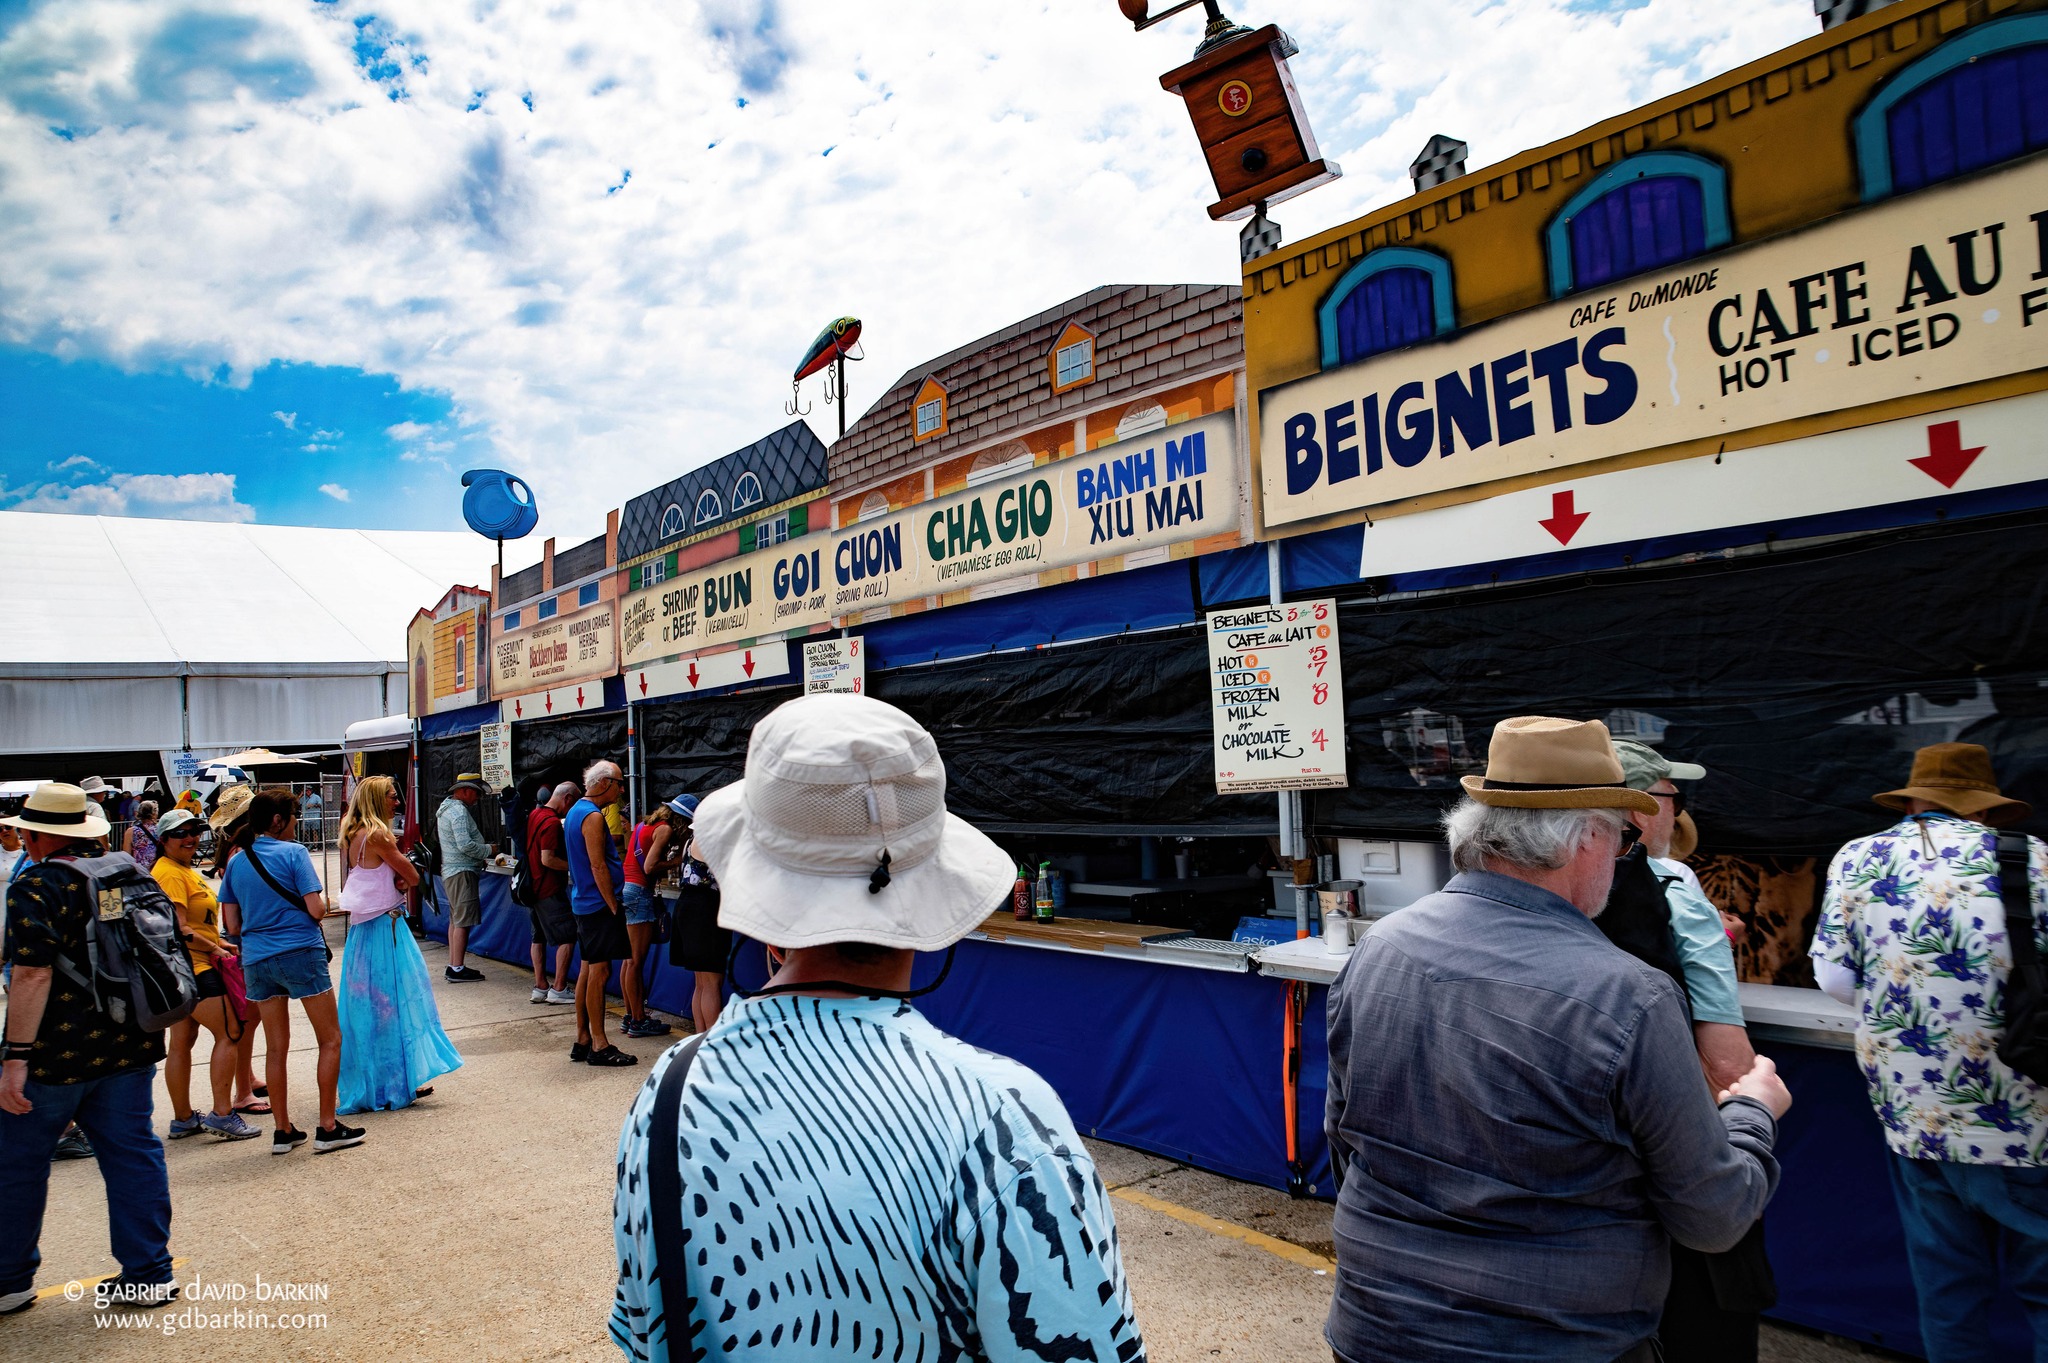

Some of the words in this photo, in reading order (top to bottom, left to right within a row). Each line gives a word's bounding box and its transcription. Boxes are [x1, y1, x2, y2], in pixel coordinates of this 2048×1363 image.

[1708, 261, 1870, 357] CAFE
[1897, 222, 2005, 314] AU
[1570, 298, 1616, 328] CAFE
[1719, 348, 1796, 397] HOT
[1852, 313, 1961, 366] ICED
[1284, 326, 1638, 496] BEIGNETS
[1077, 448, 1156, 508] BANH
[1166, 431, 1206, 482] MI
[926, 497, 992, 562] CHA
[996, 479, 1052, 544] GIO
[1088, 498, 1134, 544] XIU
[1146, 480, 1204, 532] MAI
[774, 548, 820, 600] GOI
[835, 522, 902, 586] CUON
[936, 555, 992, 582] (VIETNAMESE
[995, 550, 1012, 566] EGG
[1015, 539, 1042, 562] ROLL)
[662, 584, 698, 617] SHRIMP
[704, 567, 752, 618] BUN
[774, 602, 802, 622] (SHRIMP
[808, 594, 827, 611] PORK
[836, 586, 860, 605] SPRING
[864, 576, 890, 598] ROLL)
[624, 608, 655, 641] VIETNAMESE
[625, 609, 632, 626] BA
[633, 596, 647, 617] MIEN
[706, 608, 748, 638] (VERMICELLI)
[1212, 610, 1283, 629] BEIGNETS
[1288, 608, 1298, 622] 3
[1312, 603, 1328, 620] $5
[569, 619, 591, 637] MANDARIN
[592, 613, 610, 630] ORANGE
[672, 611, 697, 640] BEEF
[1228, 633, 1265, 648] CAFE
[1268, 634, 1283, 644] au
[1286, 626, 1316, 642] LAIT
[497, 639, 524, 657] ROSEMINT
[579, 631, 599, 648] HERBAL
[626, 628, 644, 655] CUISINE
[806, 646, 816, 655] GOI
[818, 642, 836, 653] CUON
[500, 653, 520, 669] HERBAL
[1218, 656, 1244, 672] HOT
[1308, 646, 1328, 661] $5
[809, 682, 819, 691] CHA
[820, 682, 829, 690] GIO
[1222, 672, 1256, 687] ICED
[1222, 688, 1280, 704] FROZEN
[1228, 704, 1268, 722] MILK
[1238, 722, 1252, 731] or
[1222, 730, 1291, 750] CHOCOLATE
[1246, 744, 1304, 762] MILK
[1234, 932, 1277, 946] Lasko
